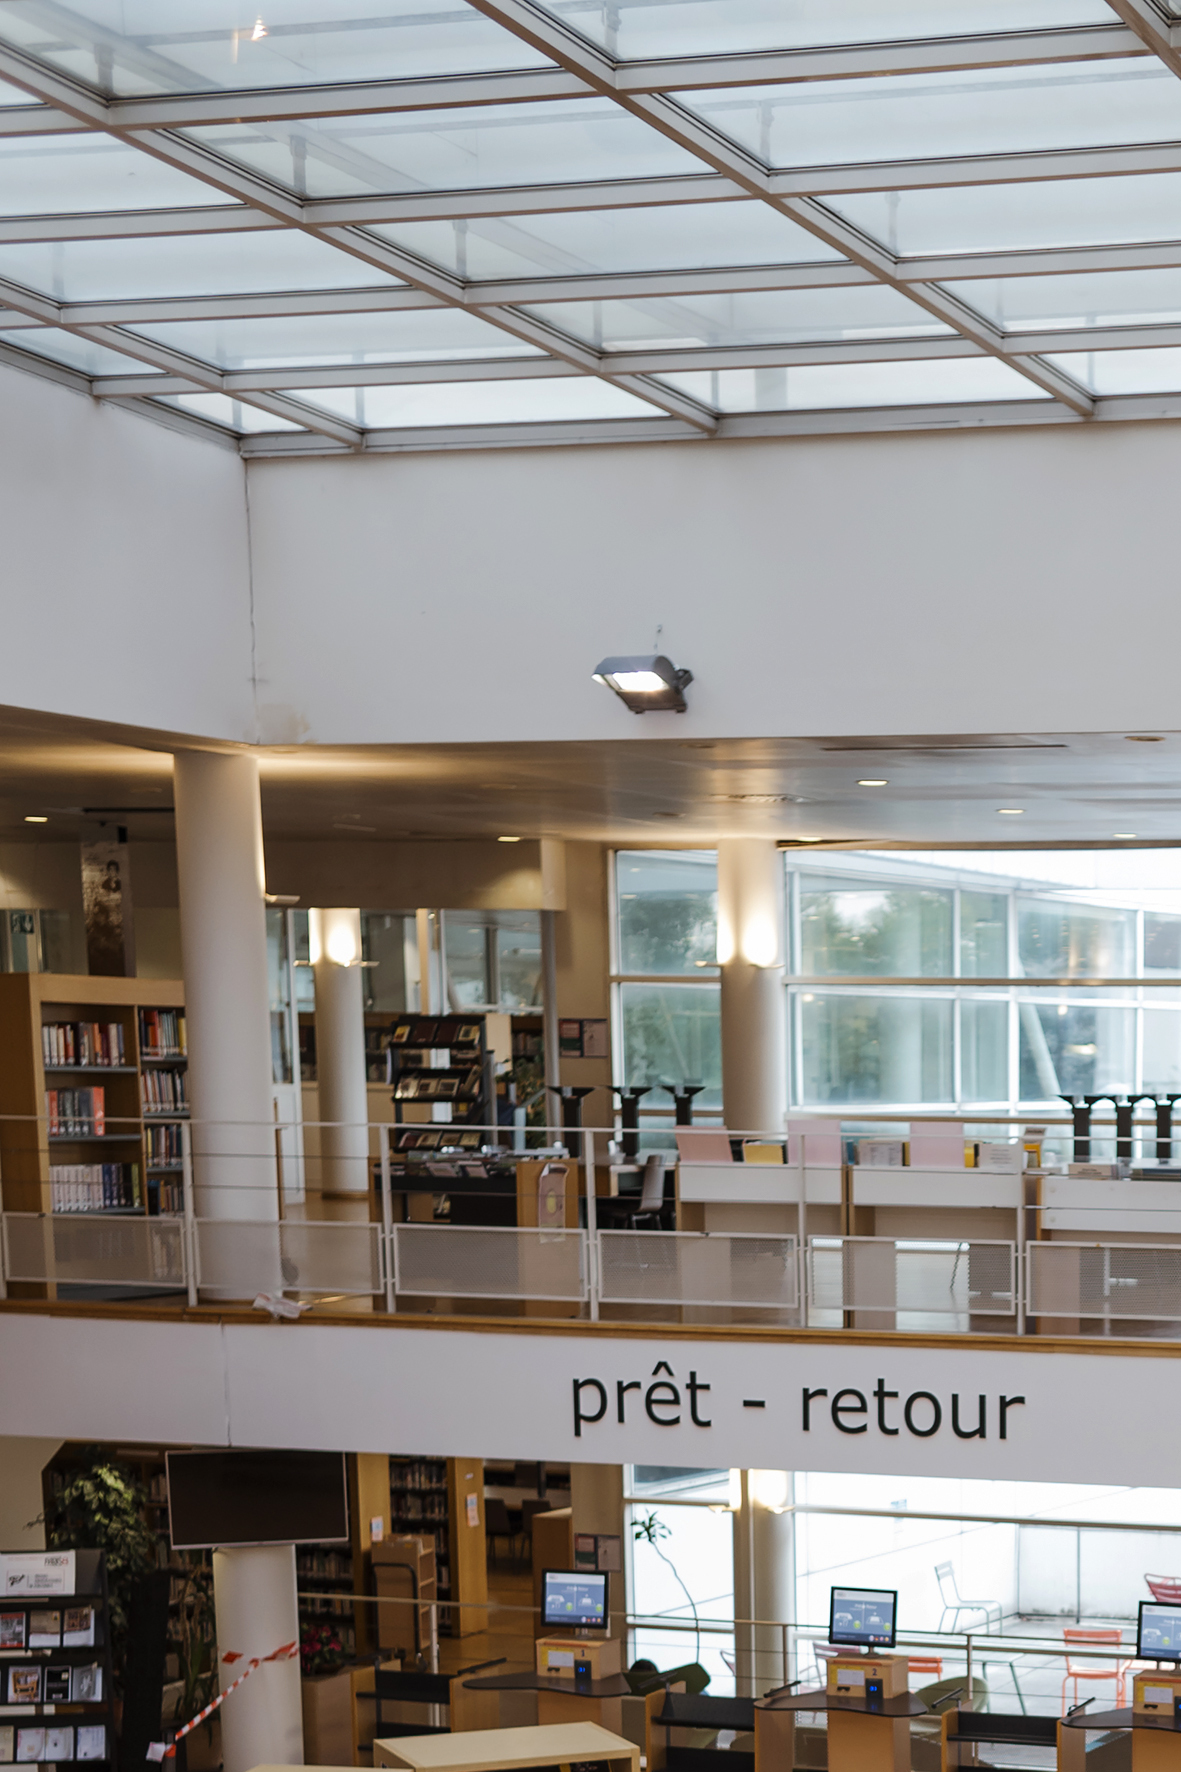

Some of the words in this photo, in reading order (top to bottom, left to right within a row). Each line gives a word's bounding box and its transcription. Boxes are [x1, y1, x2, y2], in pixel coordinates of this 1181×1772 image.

[572, 1361, 713, 1438] prêt
[742, 1398, 766, 1410] -
[802, 1377, 1026, 1440] retour
